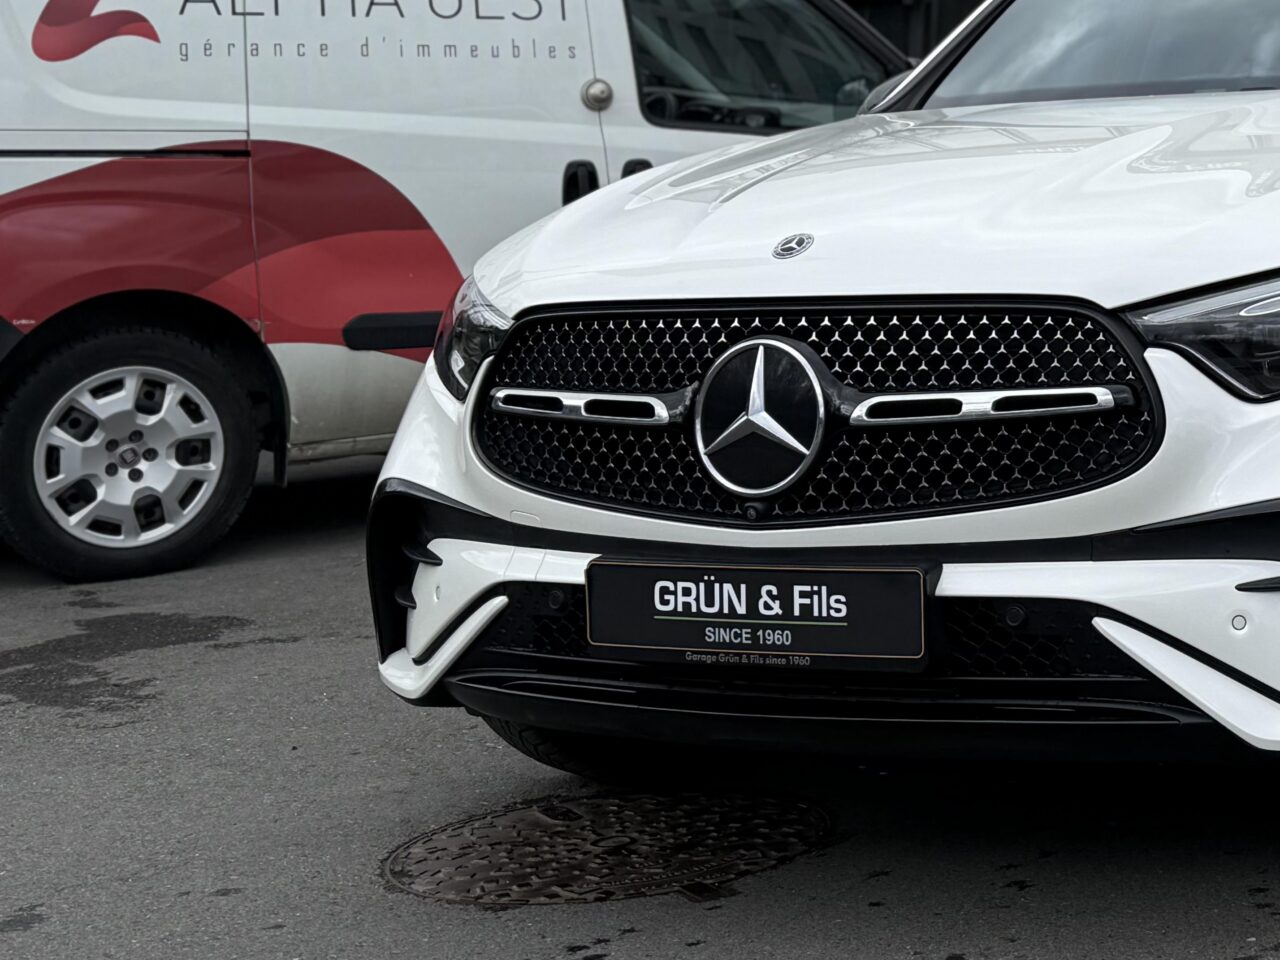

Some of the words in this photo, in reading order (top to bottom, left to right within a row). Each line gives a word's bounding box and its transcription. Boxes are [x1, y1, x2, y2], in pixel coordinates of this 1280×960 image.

[179, 39, 330, 62] gérance
[360, 36, 577, 61] d'immeubles
[653, 575, 747, 614] GRÜN
[757, 584, 783, 616] &
[793, 585, 848, 618] Fils
[704, 627, 752, 645] SINCE
[756, 629, 792, 646] 1960
[685, 651, 717, 664] Garage
[718, 653, 740, 663] Grün
[741, 654, 748, 664] &
[750, 654, 762, 665] Fils
[765, 655, 787, 665] since
[789, 656, 810, 666] 1960
